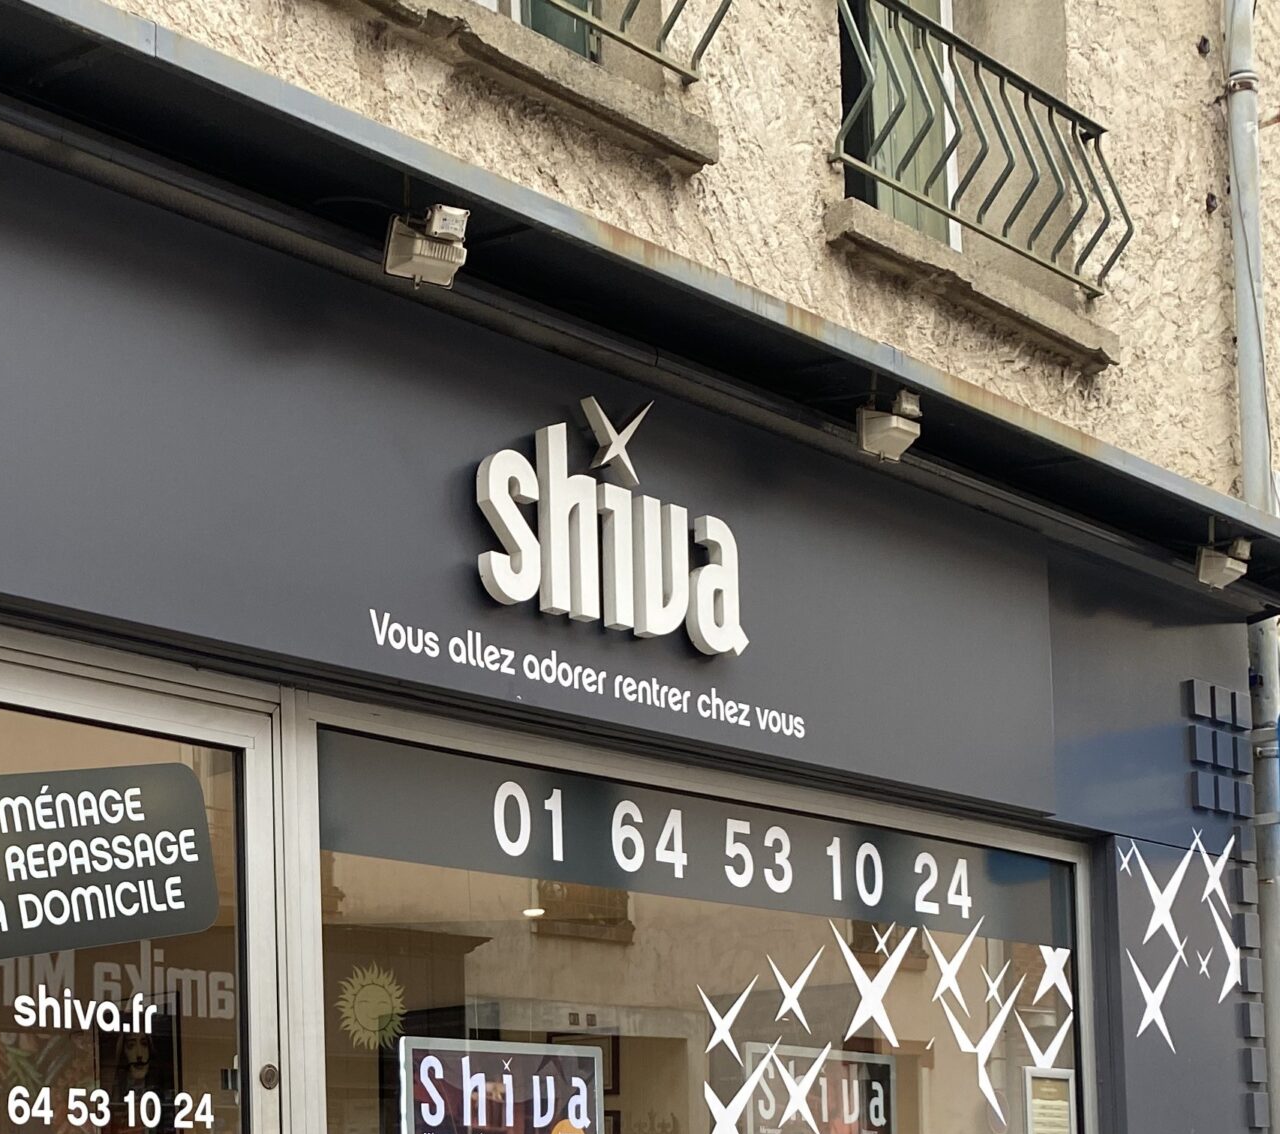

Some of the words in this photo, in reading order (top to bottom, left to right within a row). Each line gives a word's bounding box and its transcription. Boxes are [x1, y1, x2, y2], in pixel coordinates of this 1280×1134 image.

[476, 396, 750, 657] shiva
[369, 607, 441, 658] Vous
[448, 628, 516, 676] allez
[522, 649, 607, 695] adorer
[613, 673, 693, 713] rentrer
[696, 686, 750, 727] chez
[755, 705, 806, 739] vous
[5, 828, 199, 882] REPASSAGE
[493, 780, 564, 862] 01
[611, 799, 688, 879] 64
[724, 818, 794, 894] 53
[826, 836, 884, 907] 10
[914, 851, 973, 920] 24
[18, 876, 185, 929] DOMICILE
[13, 983, 157, 1034] shiva.fr
[7, 1086, 54, 1126] 64
[67, 1088, 111, 1127] 53
[124, 1090, 162, 1128] 10
[173, 1092, 214, 1129] 24
[420, 1055, 591, 1129] Shiva
